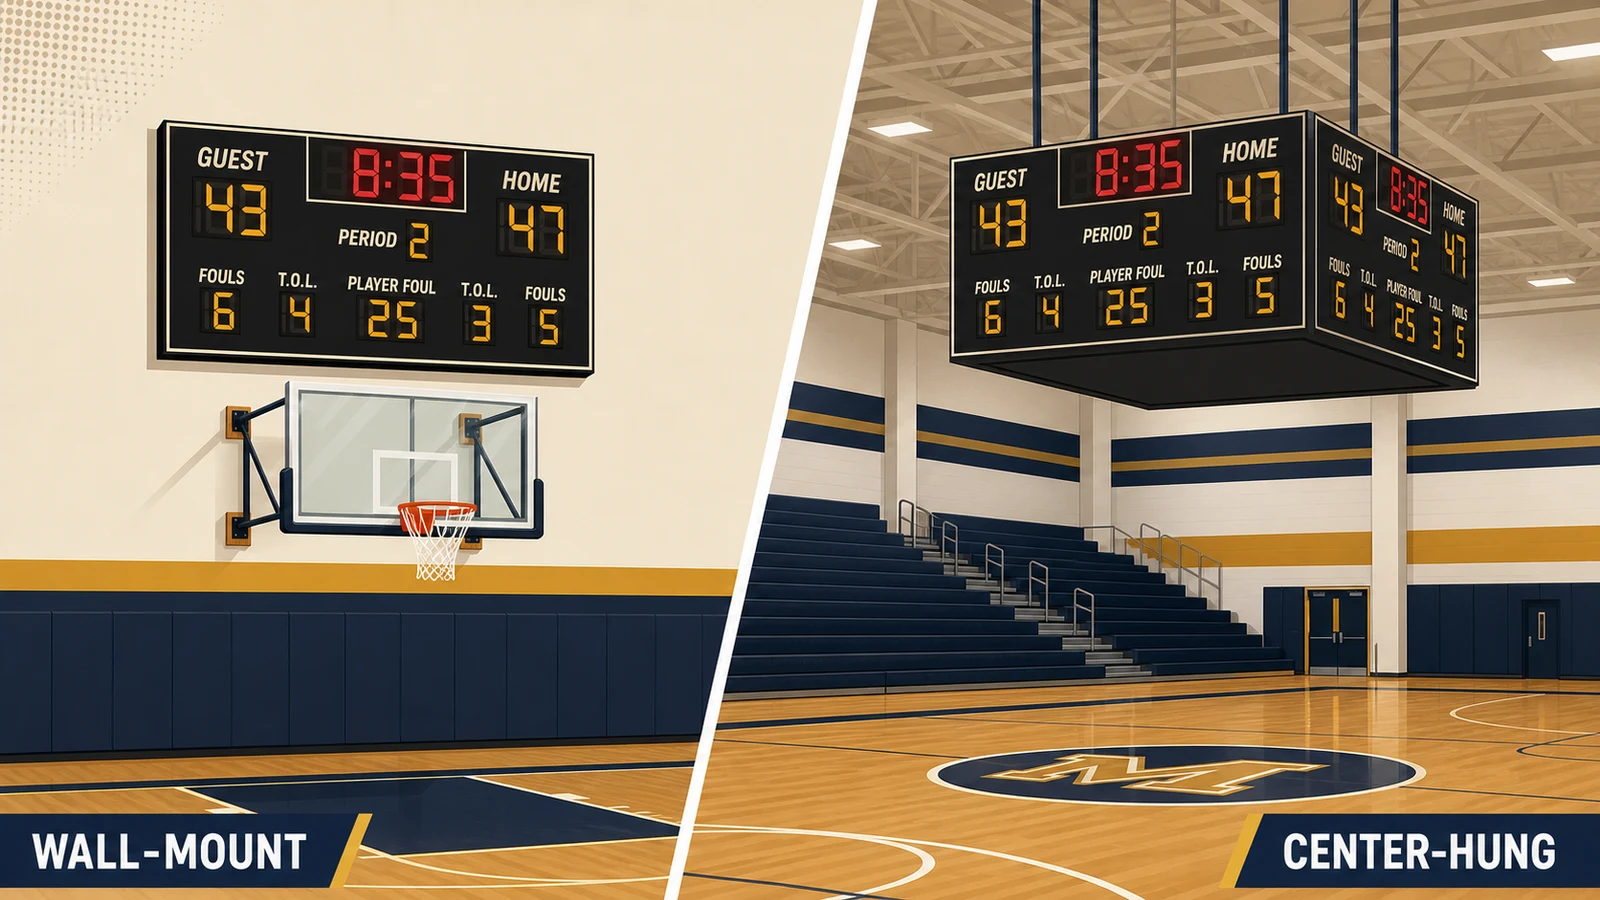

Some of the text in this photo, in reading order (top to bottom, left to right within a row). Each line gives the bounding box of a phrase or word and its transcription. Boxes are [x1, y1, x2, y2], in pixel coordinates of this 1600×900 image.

[198, 147, 268, 171] GUEST
[1223, 137, 1278, 163] HOME
[1332, 143, 1363, 174] GUEST
[352, 147, 454, 203] 8:35
[503, 170, 561, 193] HOME
[975, 168, 1027, 191] GUEST
[1095, 139, 1183, 197] 8:35
[206, 184, 266, 236] 43
[1227, 171, 1280, 222] 47
[1335, 177, 1363, 235] 43
[1390, 165, 1428, 225] 8:35
[509, 204, 563, 254] 47
[980, 199, 1026, 247] 43
[1083, 212, 1159, 246] PERIOD 2
[1443, 202, 1465, 226] HOME
[339, 223, 428, 259] PERIOD 2
[1383, 236, 1419, 271] PERIOD 2
[1445, 231, 1465, 278] 47
[199, 268, 244, 284] FOULS
[1090, 265, 1165, 284] PLAYER FOUL
[1187, 260, 1218, 275] T.O.L.
[1243, 254, 1281, 271] FOULS
[1329, 257, 1350, 276] FOULS
[1361, 269, 1377, 287] T.O.L.
[278, 272, 317, 288] T.O.L.
[348, 276, 436, 294] PLAYER FOUL
[461, 282, 497, 298] T.O.L.
[526, 286, 565, 301] FOULS
[975, 279, 1010, 294] FOULS
[1034, 274, 1065, 288] T.O.L.
[1256, 277, 1274, 314] 5
[1387, 279, 1422, 304] PLAYER FOUL
[214, 292, 234, 330] 6
[290, 297, 310, 332] 4
[1043, 296, 1059, 328] 4
[1106, 287, 1147, 325] 25
[1196, 282, 1212, 318] 3
[1336, 281, 1345, 318] 6
[1365, 293, 1373, 327] 4
[1429, 295, 1443, 311] T.O.L.
[1452, 304, 1467, 320] FOULS
[368, 300, 417, 339] 25
[473, 305, 490, 342] 3
[540, 309, 558, 345] 5
[985, 300, 1001, 334] 6
[1395, 302, 1415, 343] 25
[1433, 316, 1440, 350] 3
[1457, 325, 1464, 358] 5
[981, 753, 1330, 796] M
